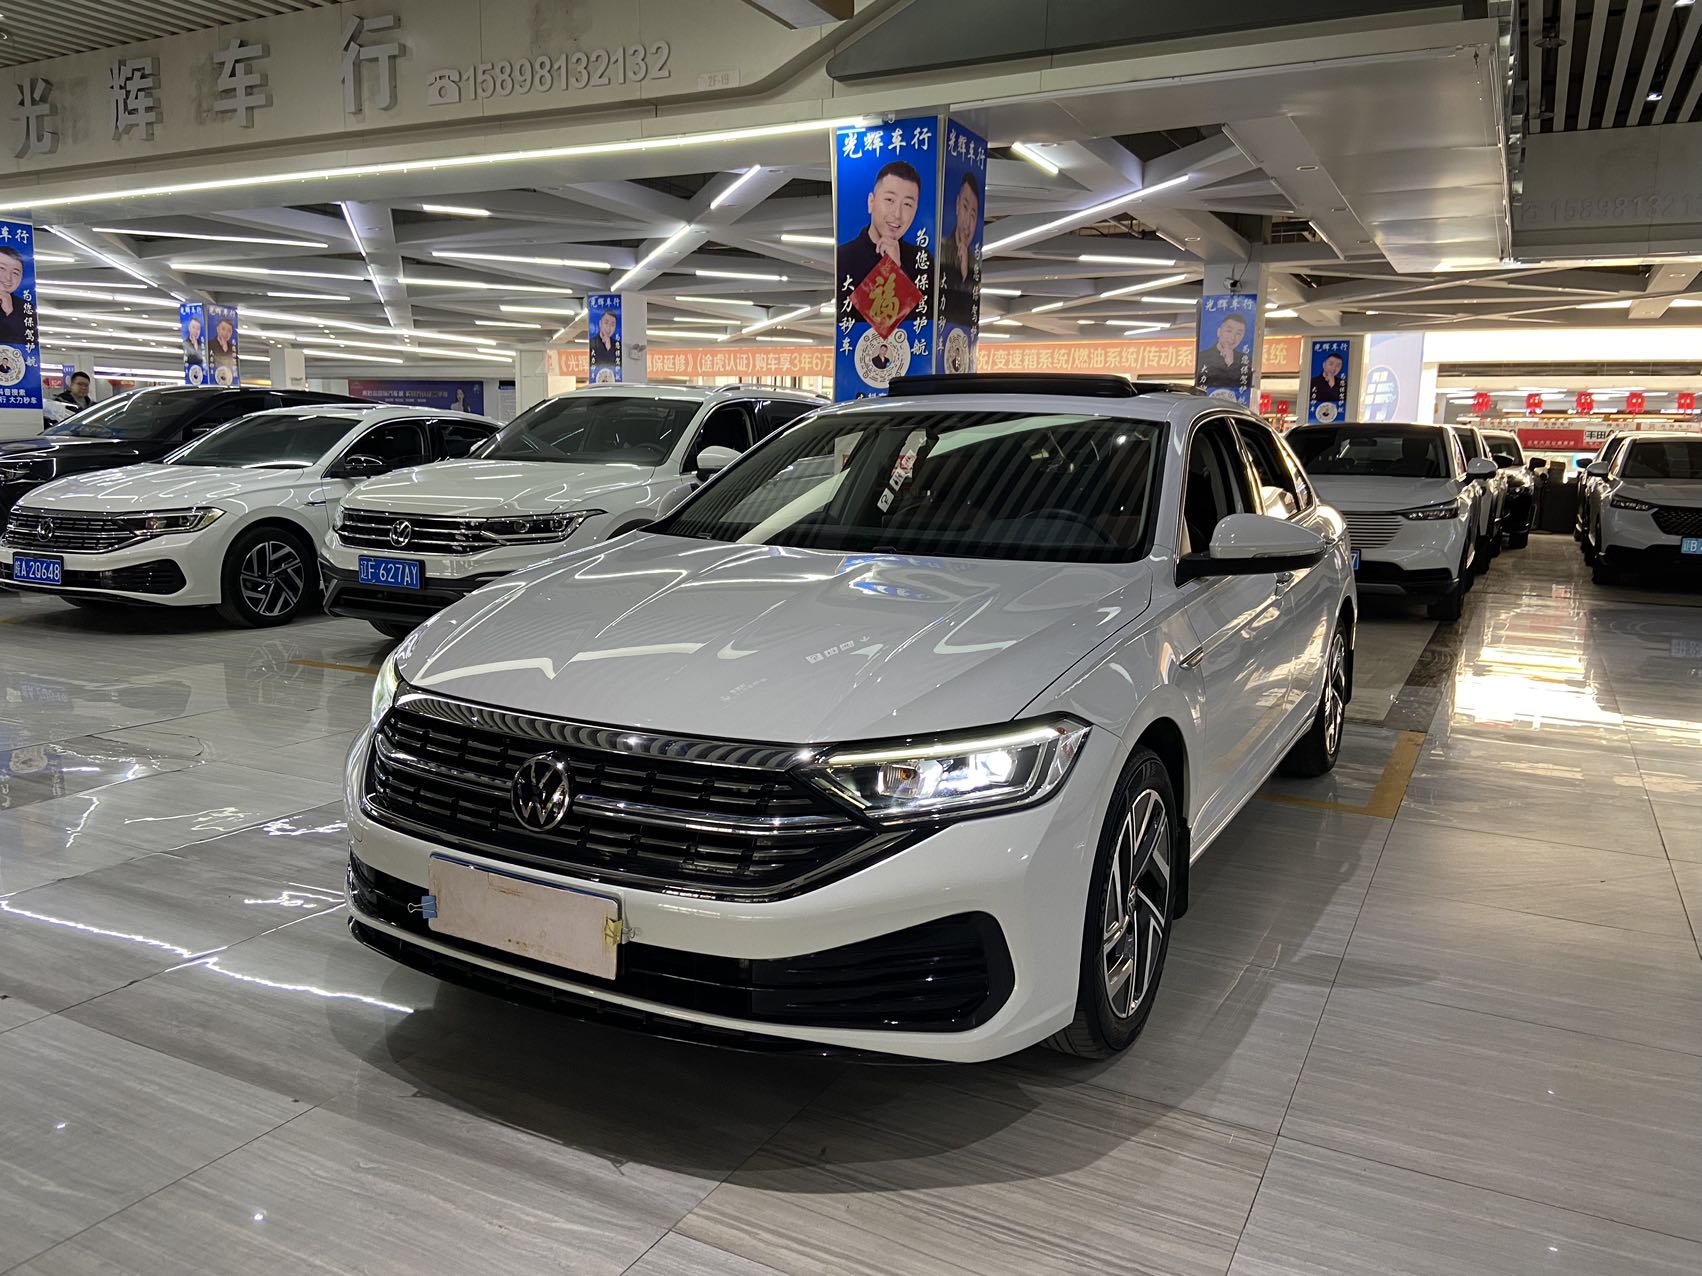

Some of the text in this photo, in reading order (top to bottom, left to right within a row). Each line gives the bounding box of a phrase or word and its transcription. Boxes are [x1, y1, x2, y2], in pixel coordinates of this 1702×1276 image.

[14, 14, 406, 161] 光辉车行
[463, 40, 671, 101] 15898132132
[842, 127, 932, 158] 光辉车行
[948, 129, 986, 170] 光辉车行
[839, 275, 855, 356] 大力秒车
[869, 273, 900, 326] 福
[1205, 299, 1253, 312] 光辉车行
[22, 290, 38, 368] 为您保驾护航
